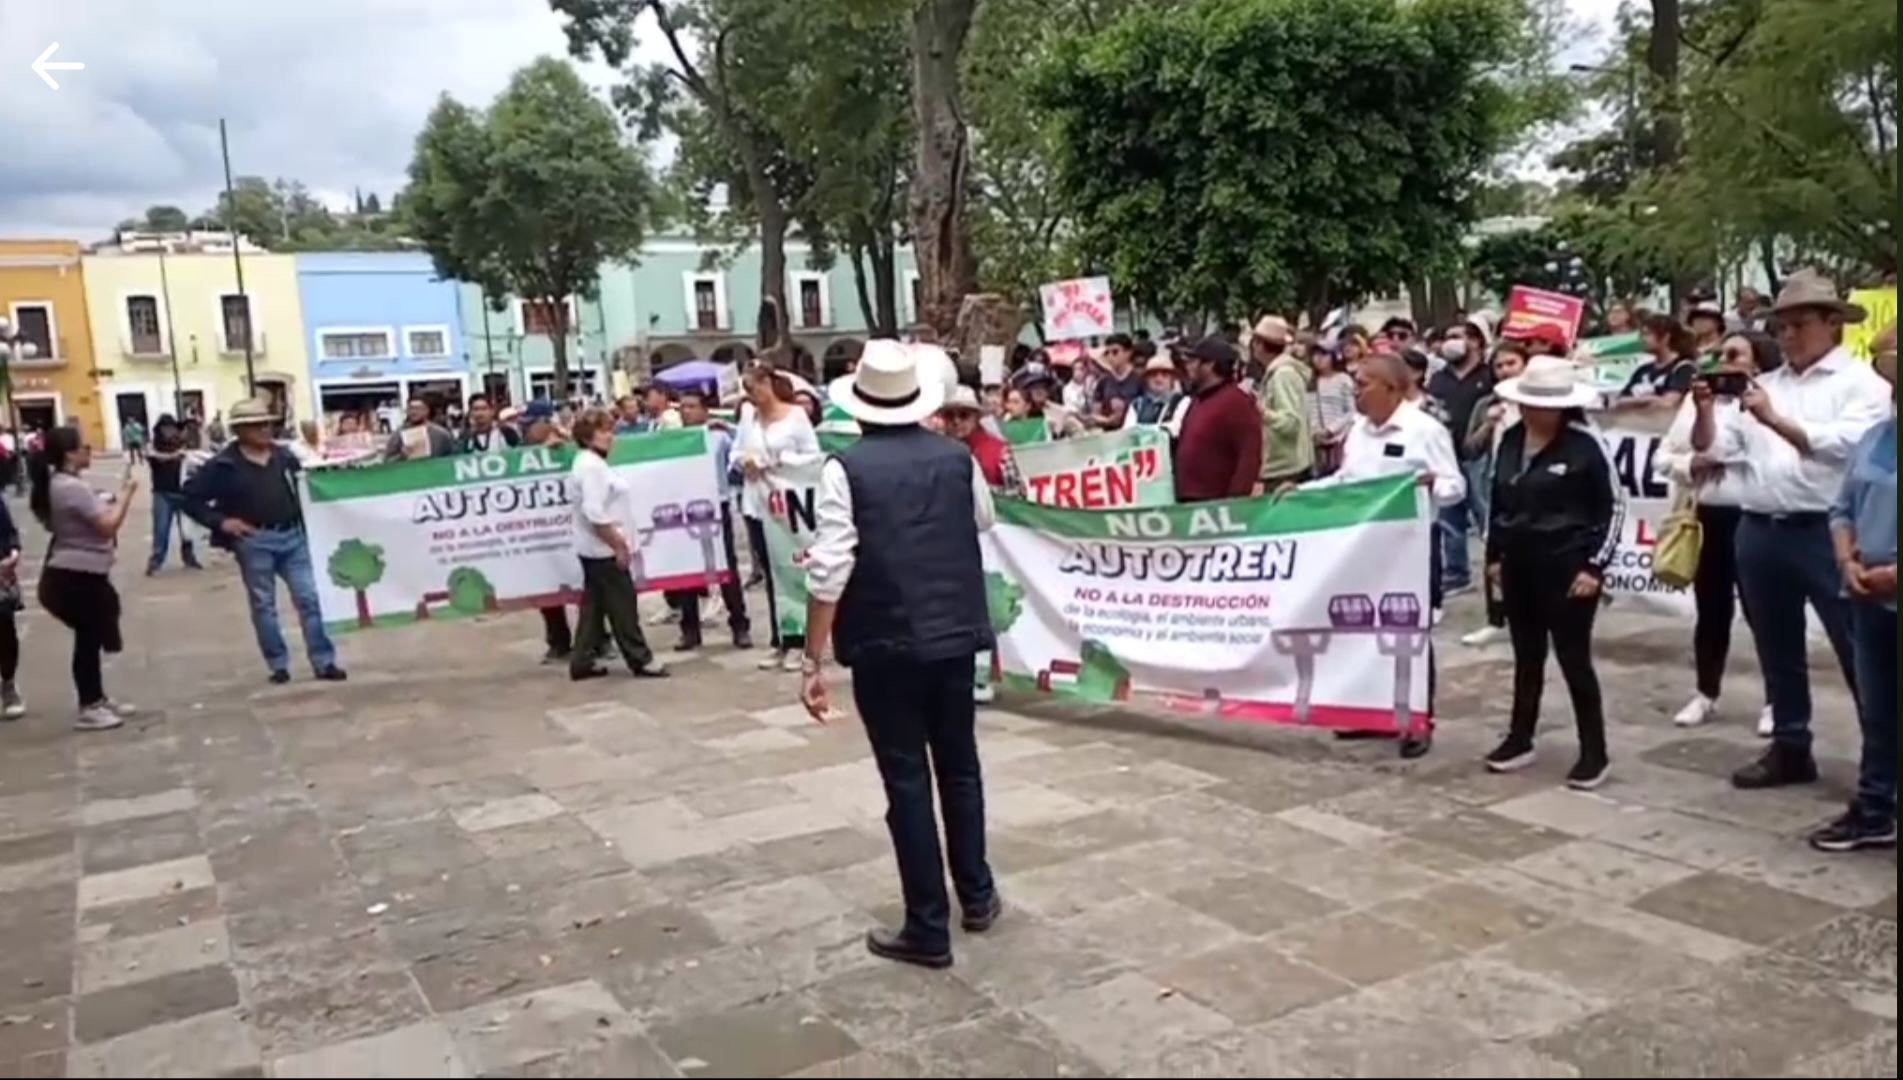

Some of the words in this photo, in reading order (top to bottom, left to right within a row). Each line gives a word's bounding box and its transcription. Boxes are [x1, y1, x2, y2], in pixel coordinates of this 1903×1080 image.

[455, 455, 507, 482] NO
[518, 448, 561, 473] AL
[412, 477, 573, 524] AUTOTR
[432, 529, 456, 541] NO
[1104, 511, 1172, 538] NO
[1188, 505, 1246, 535] AL
[1058, 540, 1297, 583] AUTOTREN
[1074, 587, 1101, 602] NO
[1105, 591, 1118, 604] A
[1122, 593, 1143, 606] LA
[1149, 592, 1270, 610] DESTRUCCIÓN
